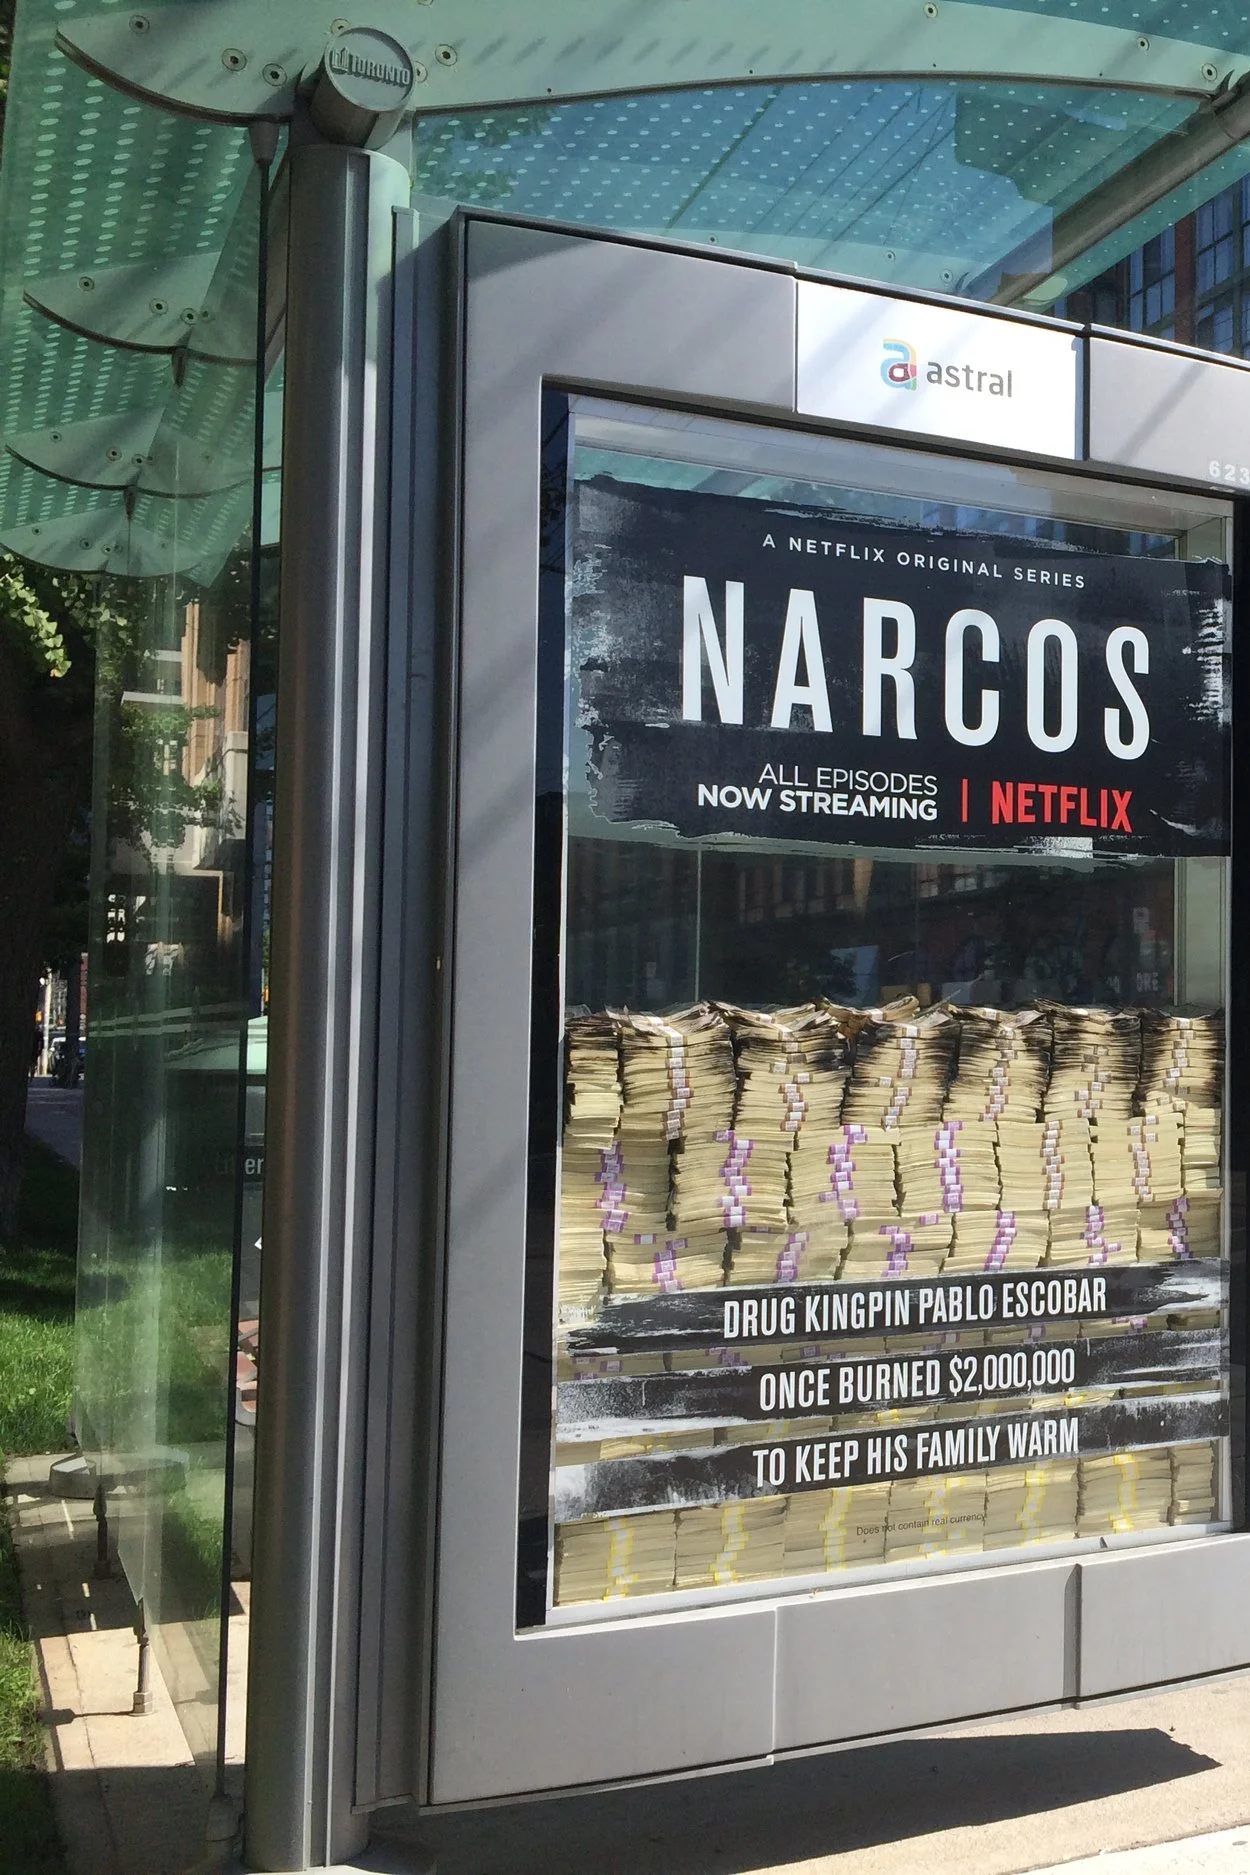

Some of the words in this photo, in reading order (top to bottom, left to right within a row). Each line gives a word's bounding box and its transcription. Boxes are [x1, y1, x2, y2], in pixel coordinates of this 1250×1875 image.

[351, 54, 411, 86] TORONTO
[926, 360, 1014, 399] astral
[762, 533, 776, 549] A
[789, 538, 885, 563] NETFLIX
[896, 551, 1003, 579] ORIGINAL
[1012, 567, 1085, 589] SERIES
[682, 574, 1150, 761] NARCOS
[696, 783, 772, 810] NOW
[778, 788, 939, 822] STREAMING
[758, 763, 809, 787] ALL
[816, 767, 939, 797] EPISODES
[991, 779, 1134, 834] NETFLIX
[722, 1294, 796, 1339] DRUG
[804, 1289, 911, 1334] KINGPIN
[918, 1284, 995, 1325] PABLO
[1002, 1277, 1108, 1320] ESCOBAR
[758, 1368, 830, 1412] ONCE
[838, 1358, 941, 1405] BURNED
[948, 1347, 1076, 1396] $2,000,000
[752, 1447, 787, 1489] TO
[793, 1440, 860, 1484] KEEP
[866, 1432, 909, 1474] HIS
[915, 1425, 999, 1471] FAMILY
[1006, 1416, 1080, 1456] WARM
[856, 1525, 880, 1537] Does
[897, 1518, 930, 1531] contain
[931, 1515, 949, 1526] real
[949, 1512, 986, 1527] currency
